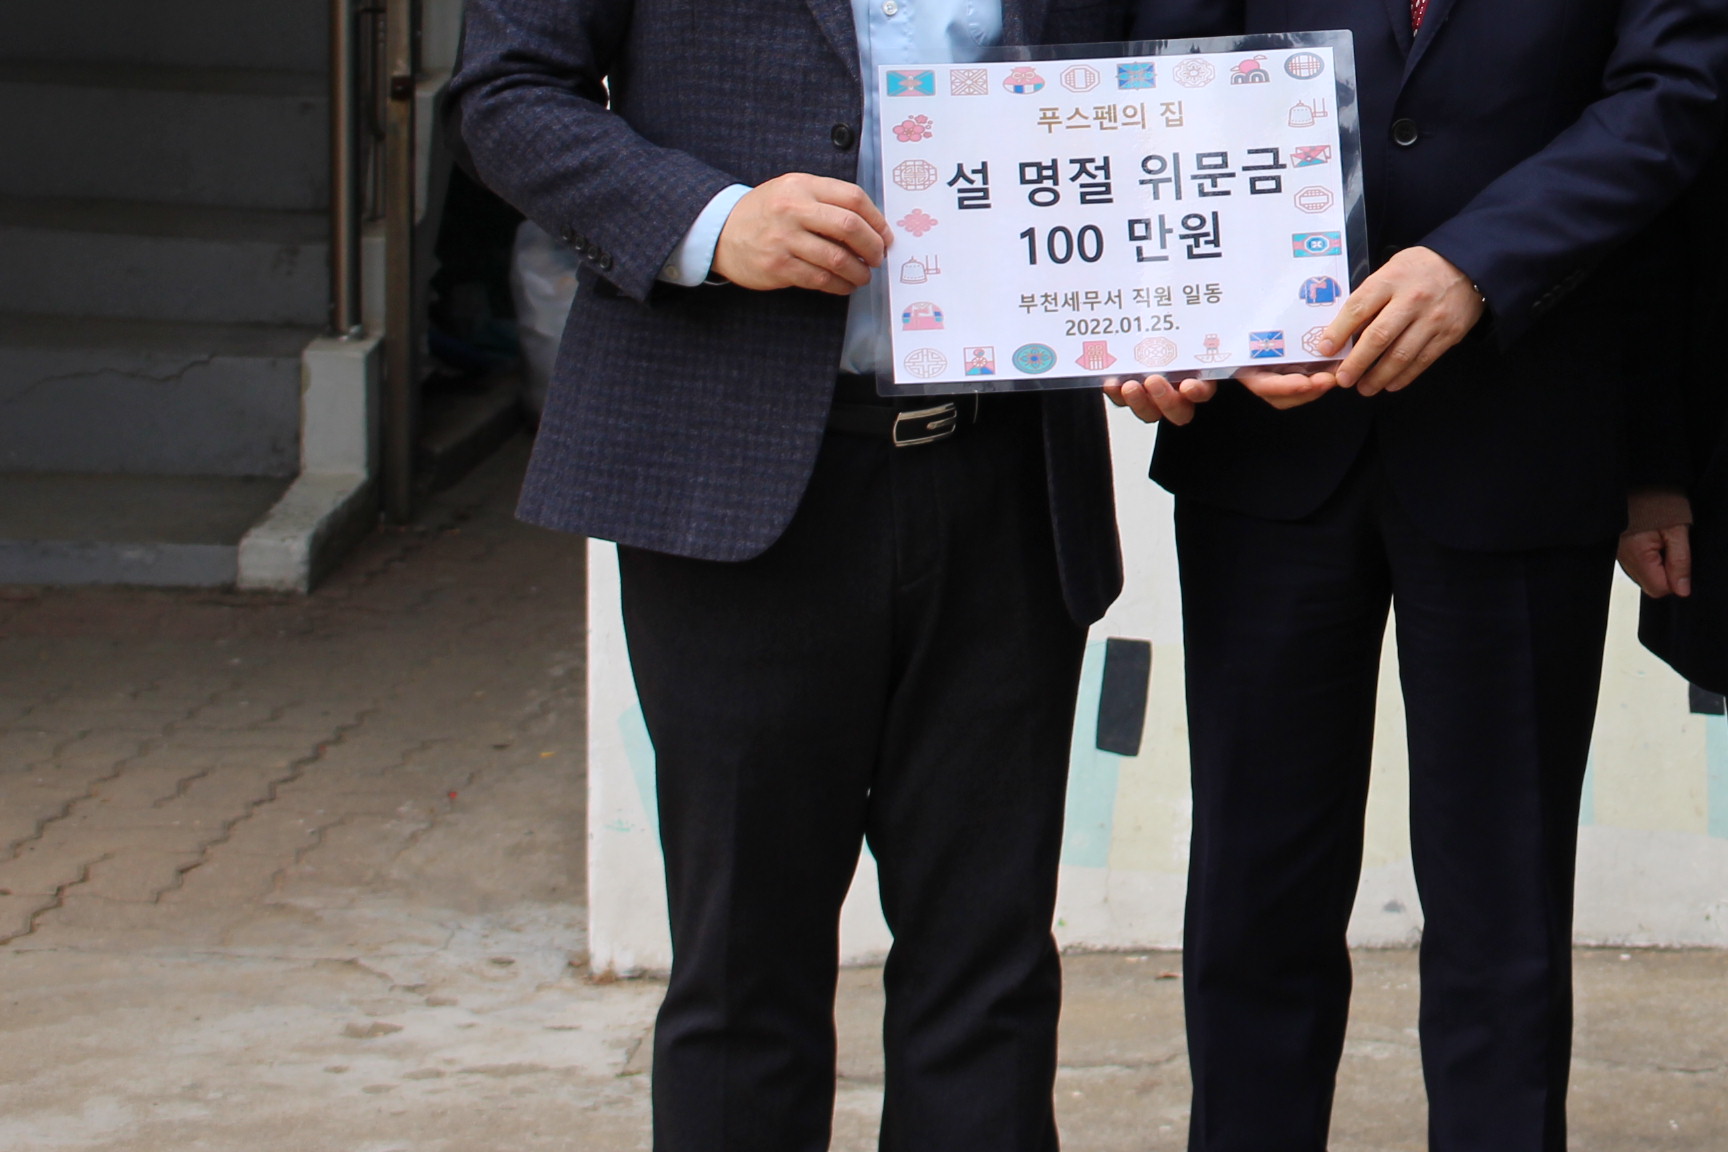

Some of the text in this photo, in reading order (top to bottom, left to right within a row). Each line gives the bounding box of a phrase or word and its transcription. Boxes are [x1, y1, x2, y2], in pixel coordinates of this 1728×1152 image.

[1037, 101, 1183, 133] 푸스펜의 집
[947, 148, 1287, 210] 설 명절 위문금
[1020, 211, 1222, 265] 100 만원
[1019, 283, 1222, 314] 부천세무서 직원 일동
[1066, 314, 1179, 336] 2022.01.25.
